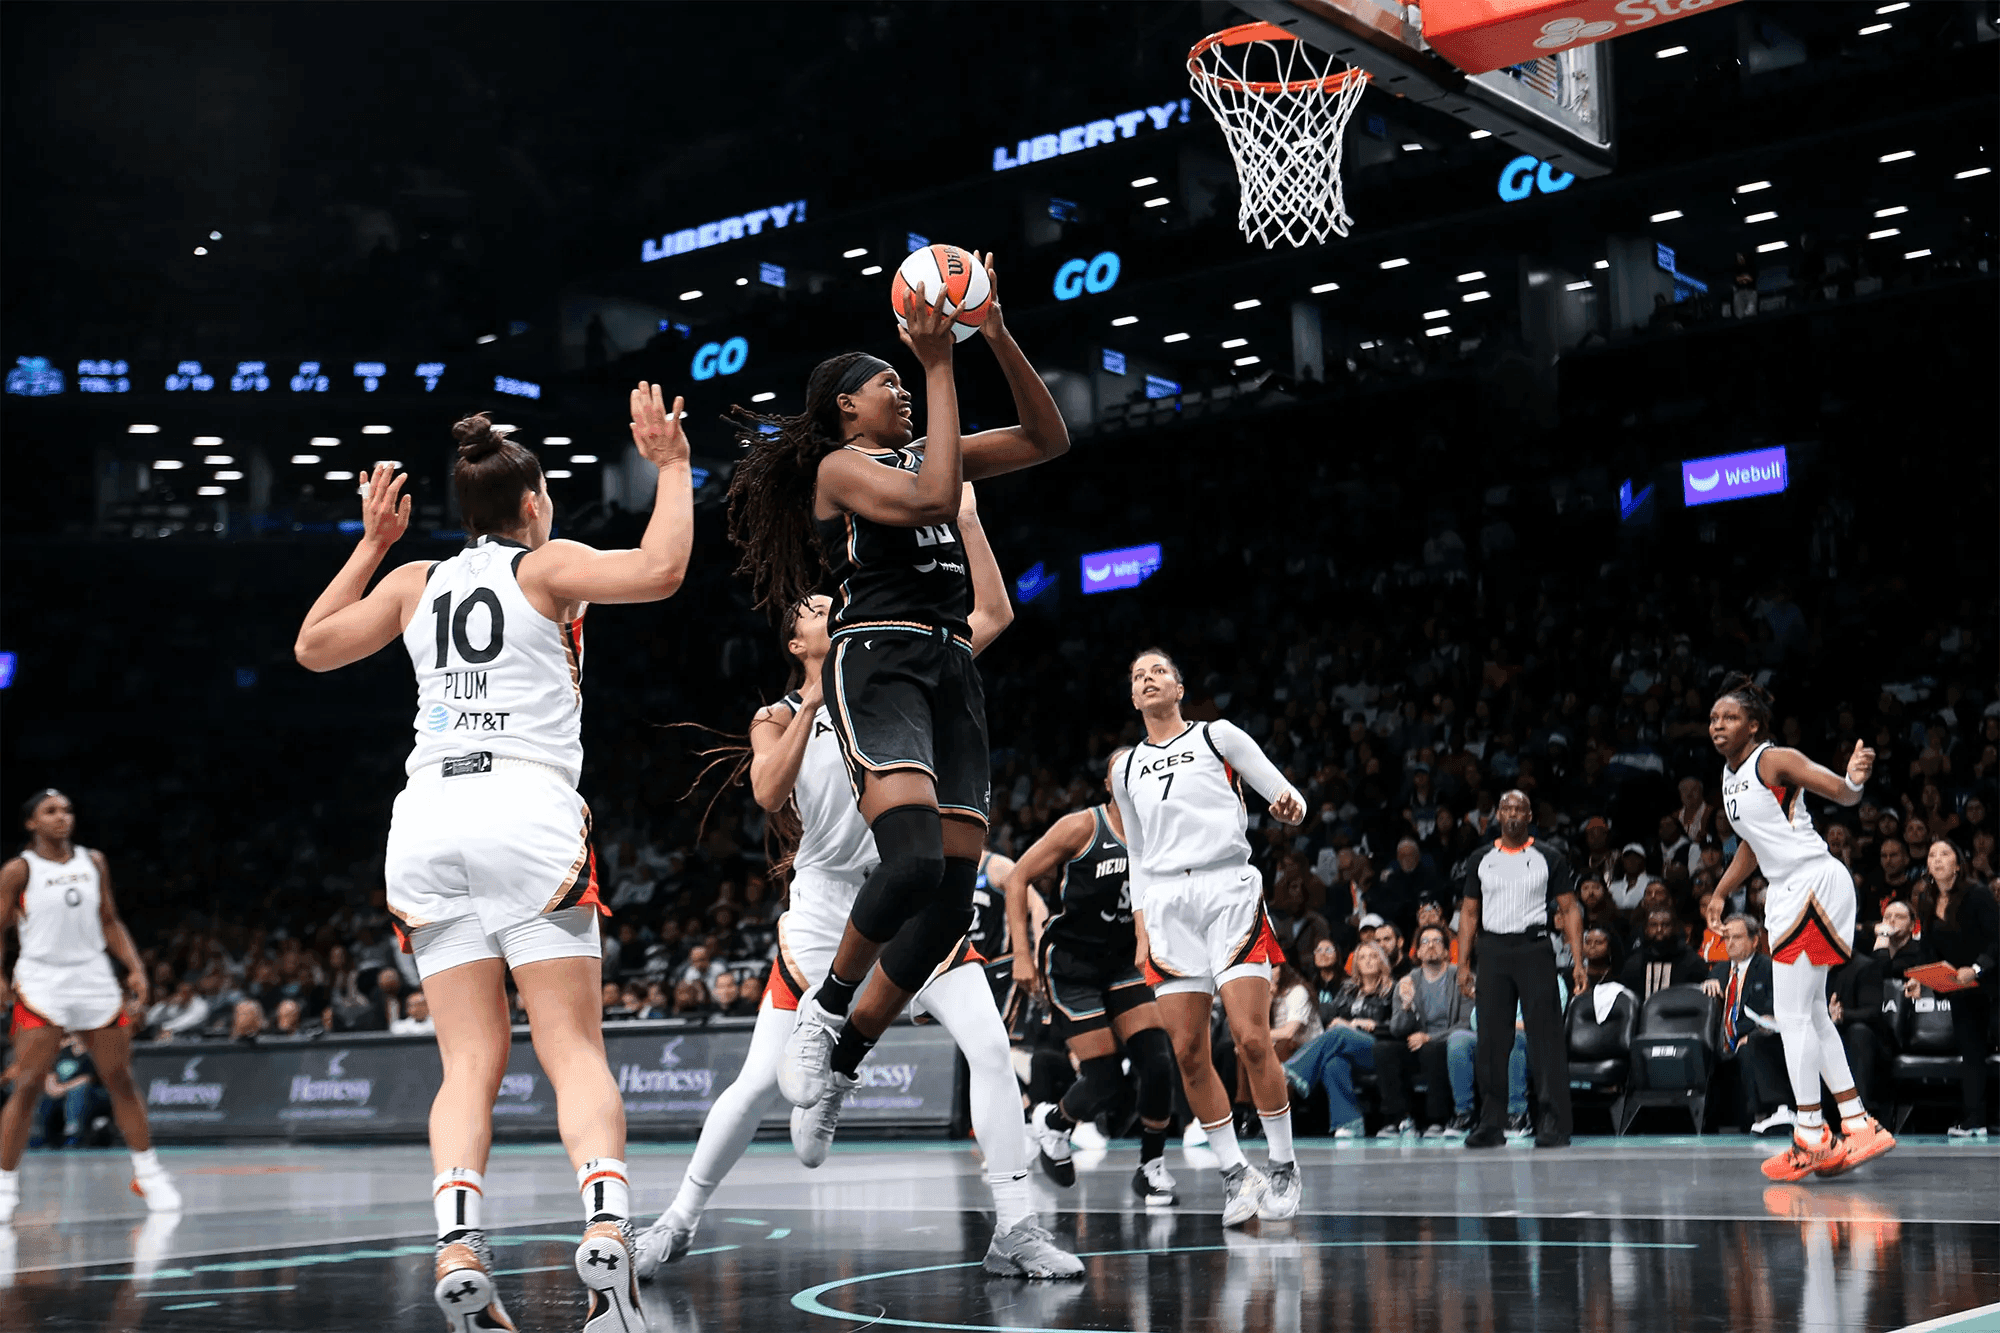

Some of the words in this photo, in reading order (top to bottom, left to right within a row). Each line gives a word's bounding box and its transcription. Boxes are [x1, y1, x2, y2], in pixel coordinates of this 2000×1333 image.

[992, 98, 1191, 172] LIBERTY!
[641, 199, 807, 263] LIBERTY!
[1053, 251, 1121, 301] GO
[690, 336, 749, 381] GO
[1725, 459, 1782, 487] Webull
[432, 586, 505, 669] 10
[444, 671, 487, 700] PLUM
[454, 711, 510, 731] AT&T
[1139, 751, 1195, 781] ACES
[1158, 772, 1175, 802] 7
[1095, 857, 1127, 879] NEW
